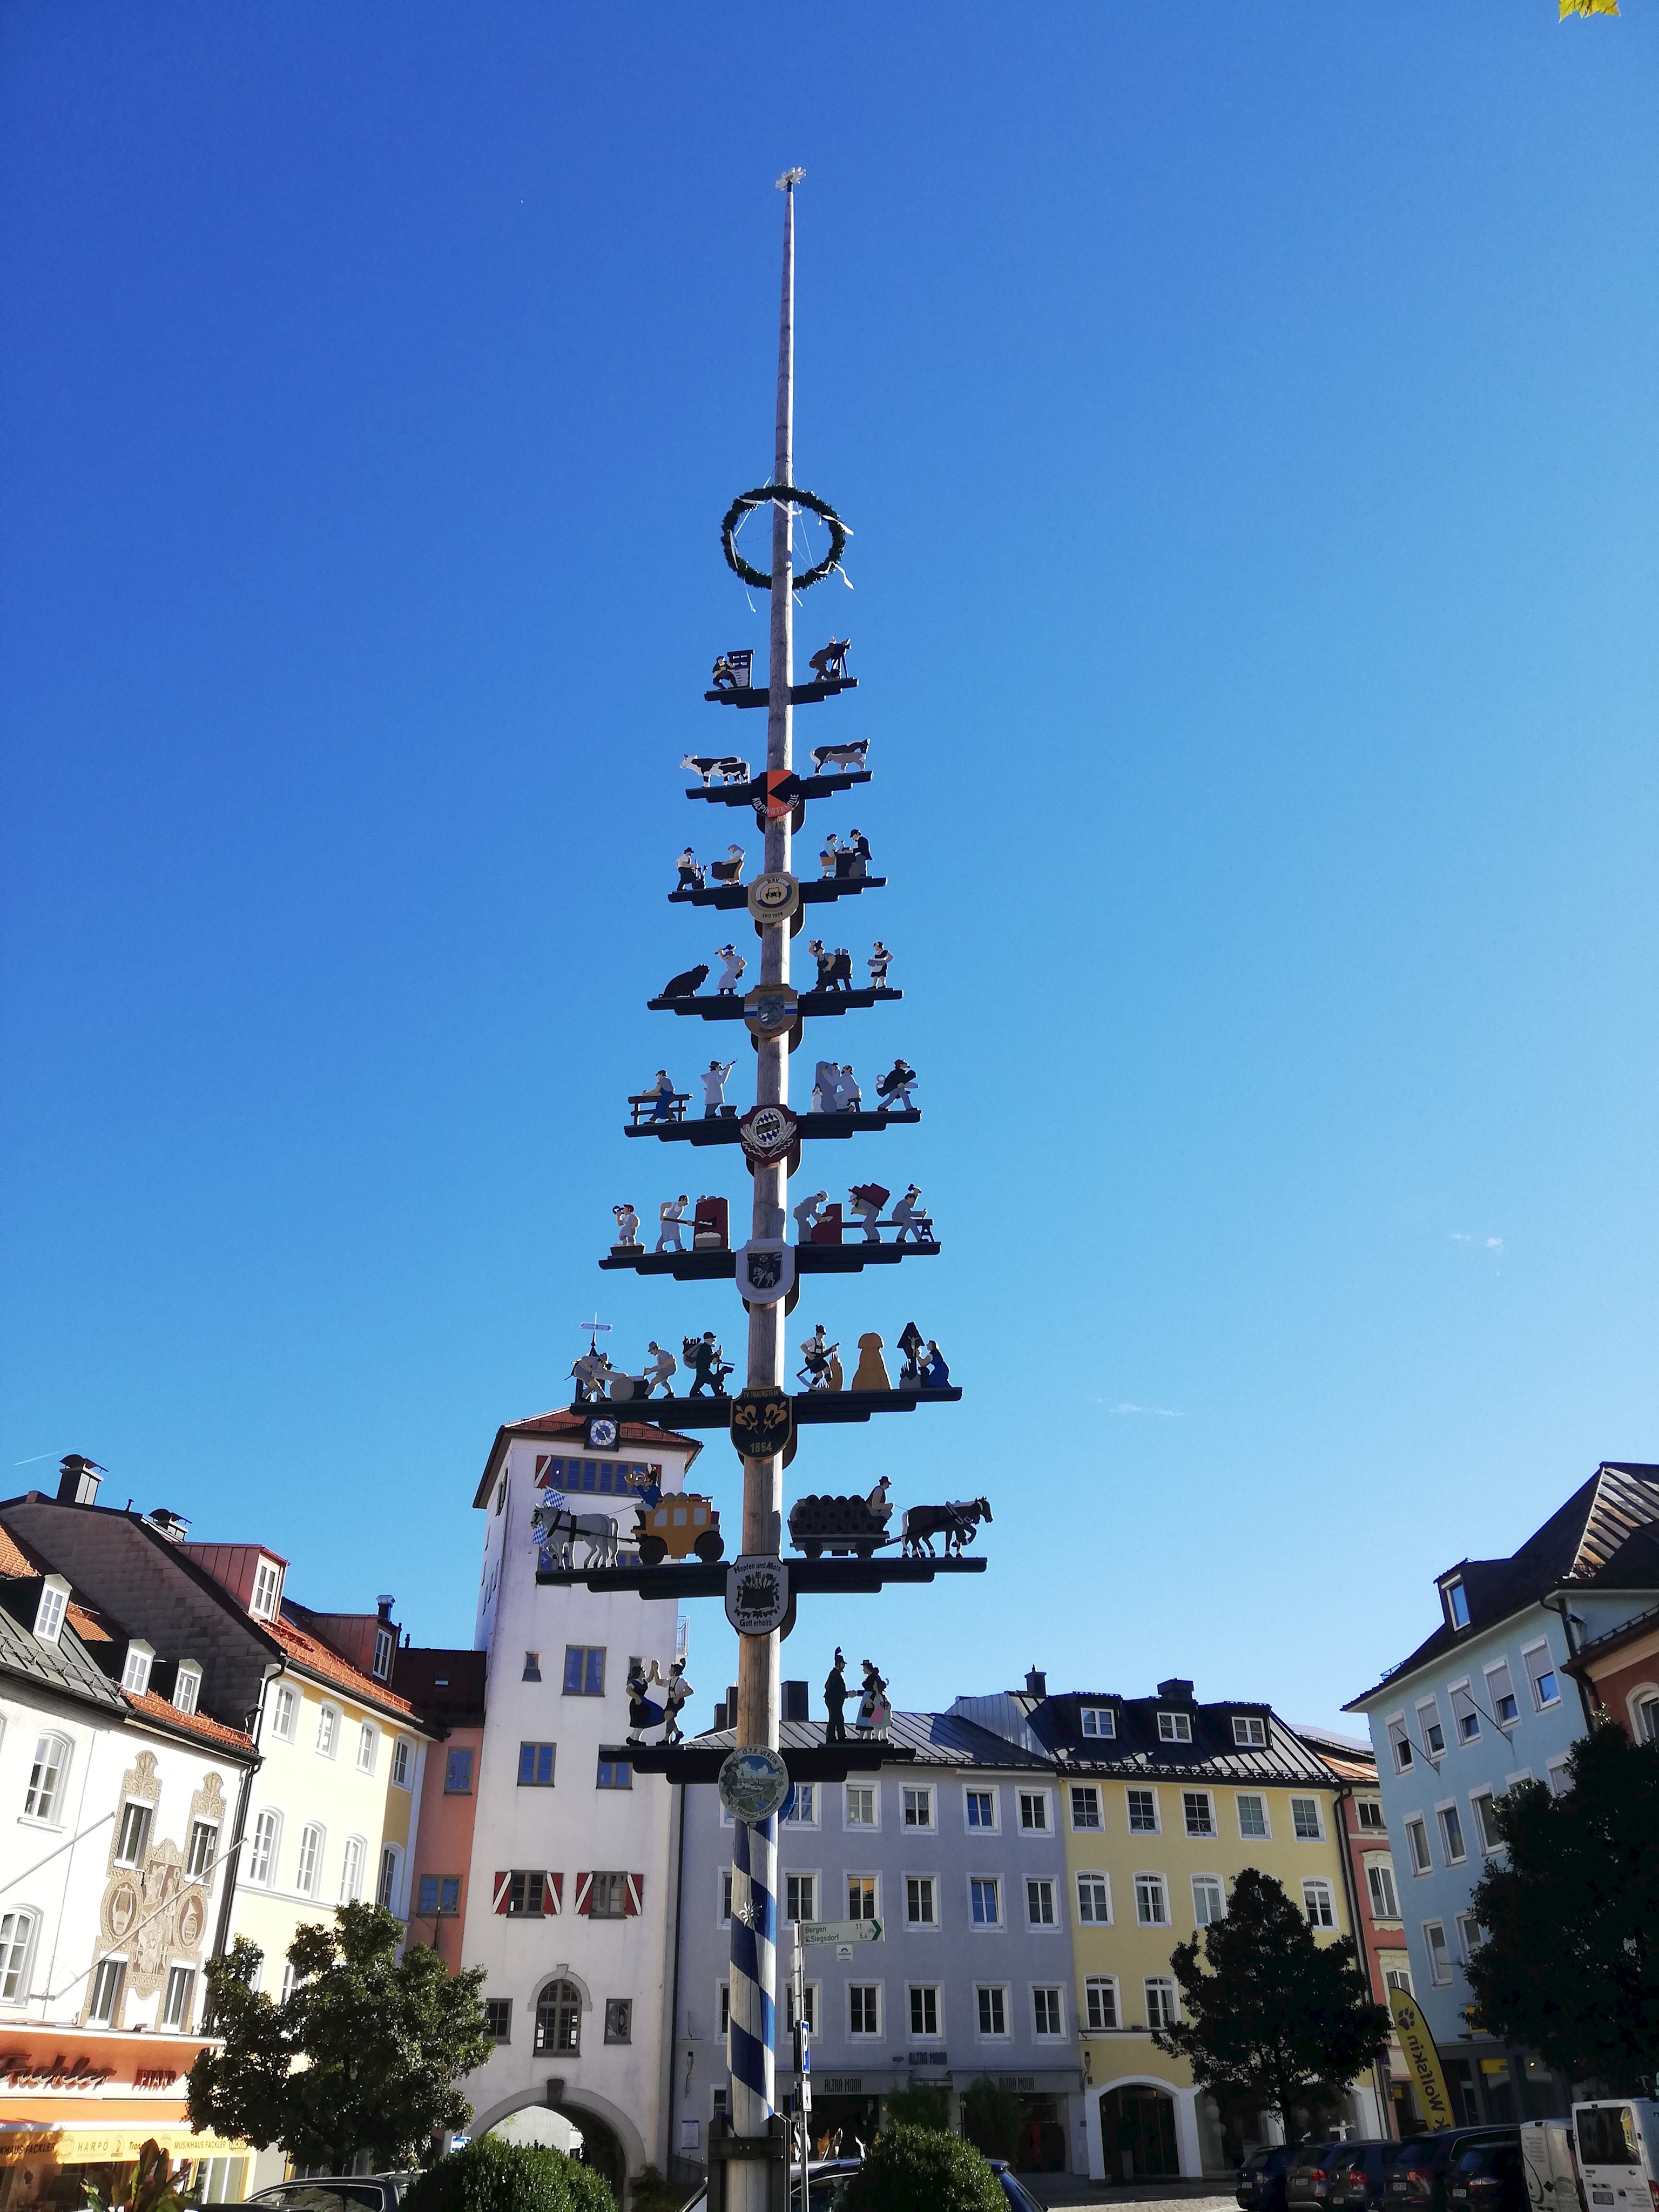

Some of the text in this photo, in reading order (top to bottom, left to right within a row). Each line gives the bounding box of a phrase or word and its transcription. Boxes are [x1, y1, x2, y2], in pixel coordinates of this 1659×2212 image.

[752, 794, 799, 814] KOLPINGFAMILIE
[750, 1441, 772, 1453] 1864
[734, 1564, 756, 1573] Hopfen
[766, 1562, 781, 1572] Malz
[760, 1749, 779, 1765] VEREIN
[759, 1796, 780, 1816] TRAUNSTEIN
[805, 1926, 826, 1934] Bergen
[811, 1934, 839, 1943] Siegsdorf
[802, 2027, 808, 2066] P
[825, 2079, 862, 2093] ALTRA MODA
[1017, 2077, 1034, 2091] MODA
[25, 2142, 55, 2154] FACKLER
[174, 2141, 204, 2149] MUSIKHAUS
[205, 2141, 226, 2149] FACKLER
